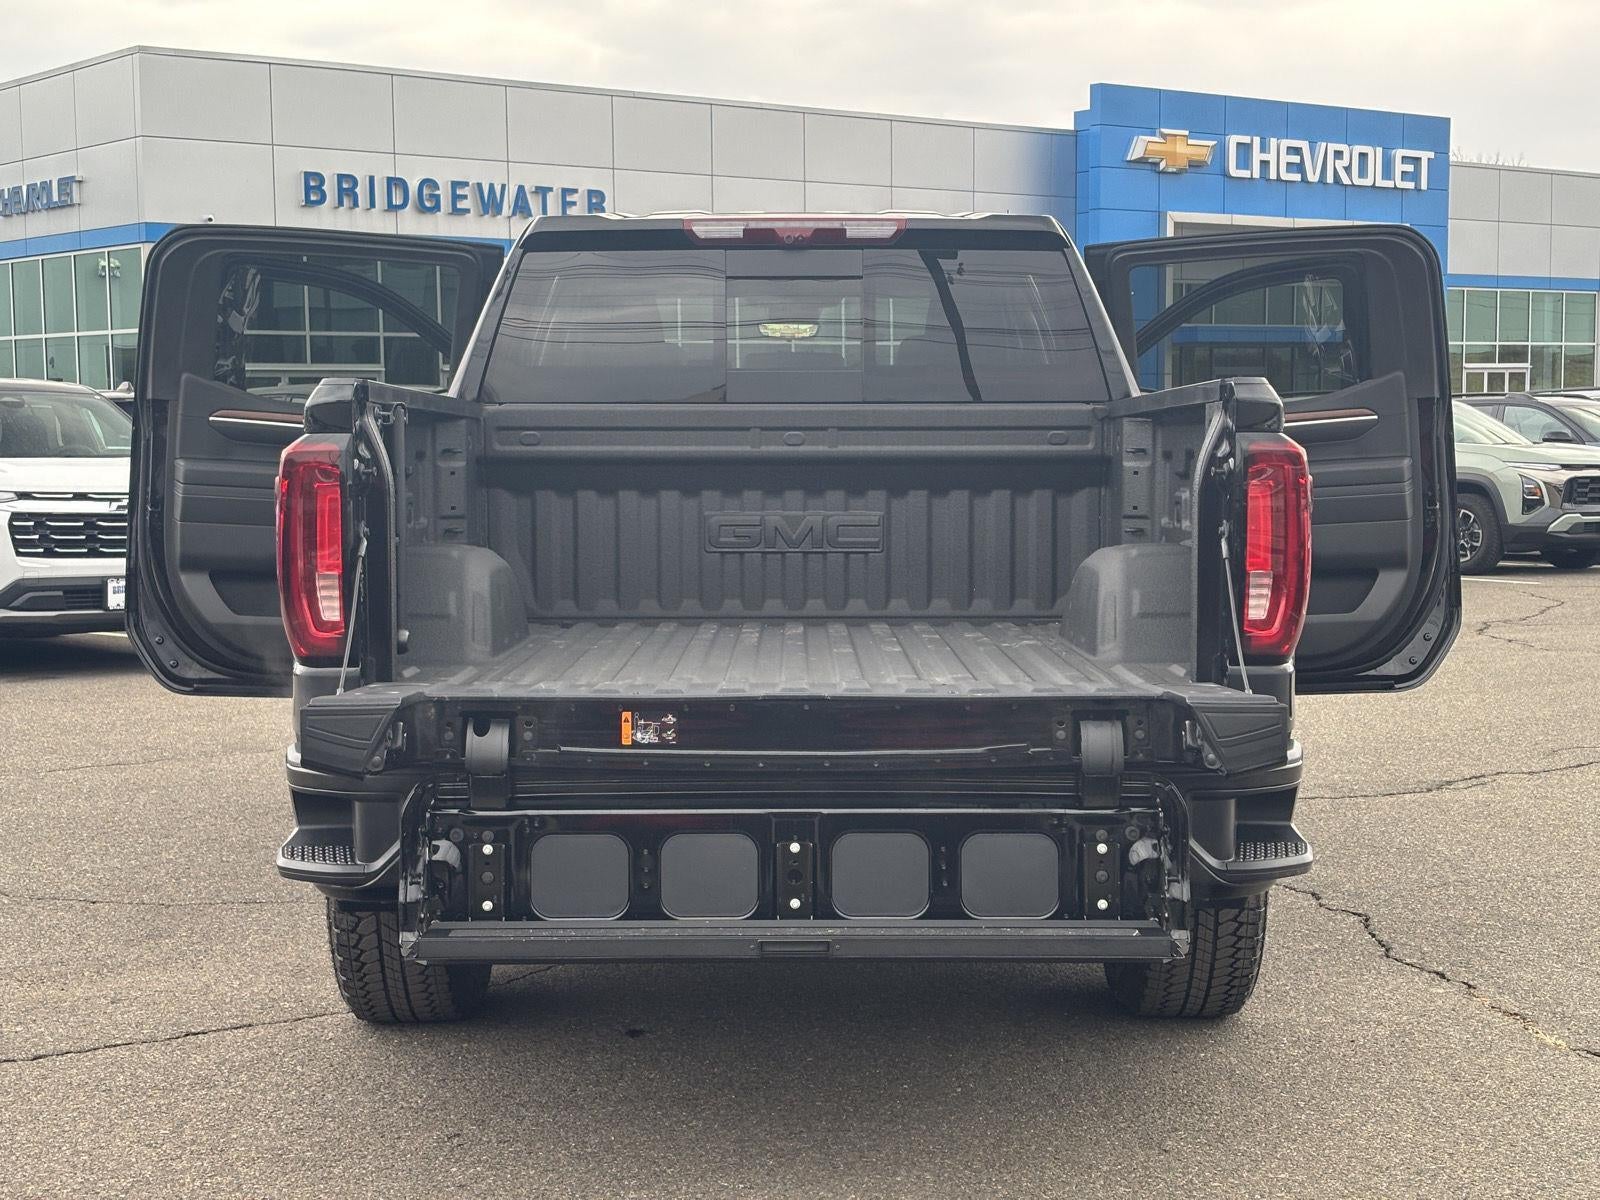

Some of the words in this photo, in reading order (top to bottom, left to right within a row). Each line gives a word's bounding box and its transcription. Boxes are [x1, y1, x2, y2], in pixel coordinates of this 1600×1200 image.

[1226, 134, 1435, 191] CHEVROLET
[0, 175, 83, 217] HEVROLET
[302, 170, 607, 218] BRIDGEWATER
[708, 514, 881, 549] GMC
[112, 584, 126, 595] BRI
